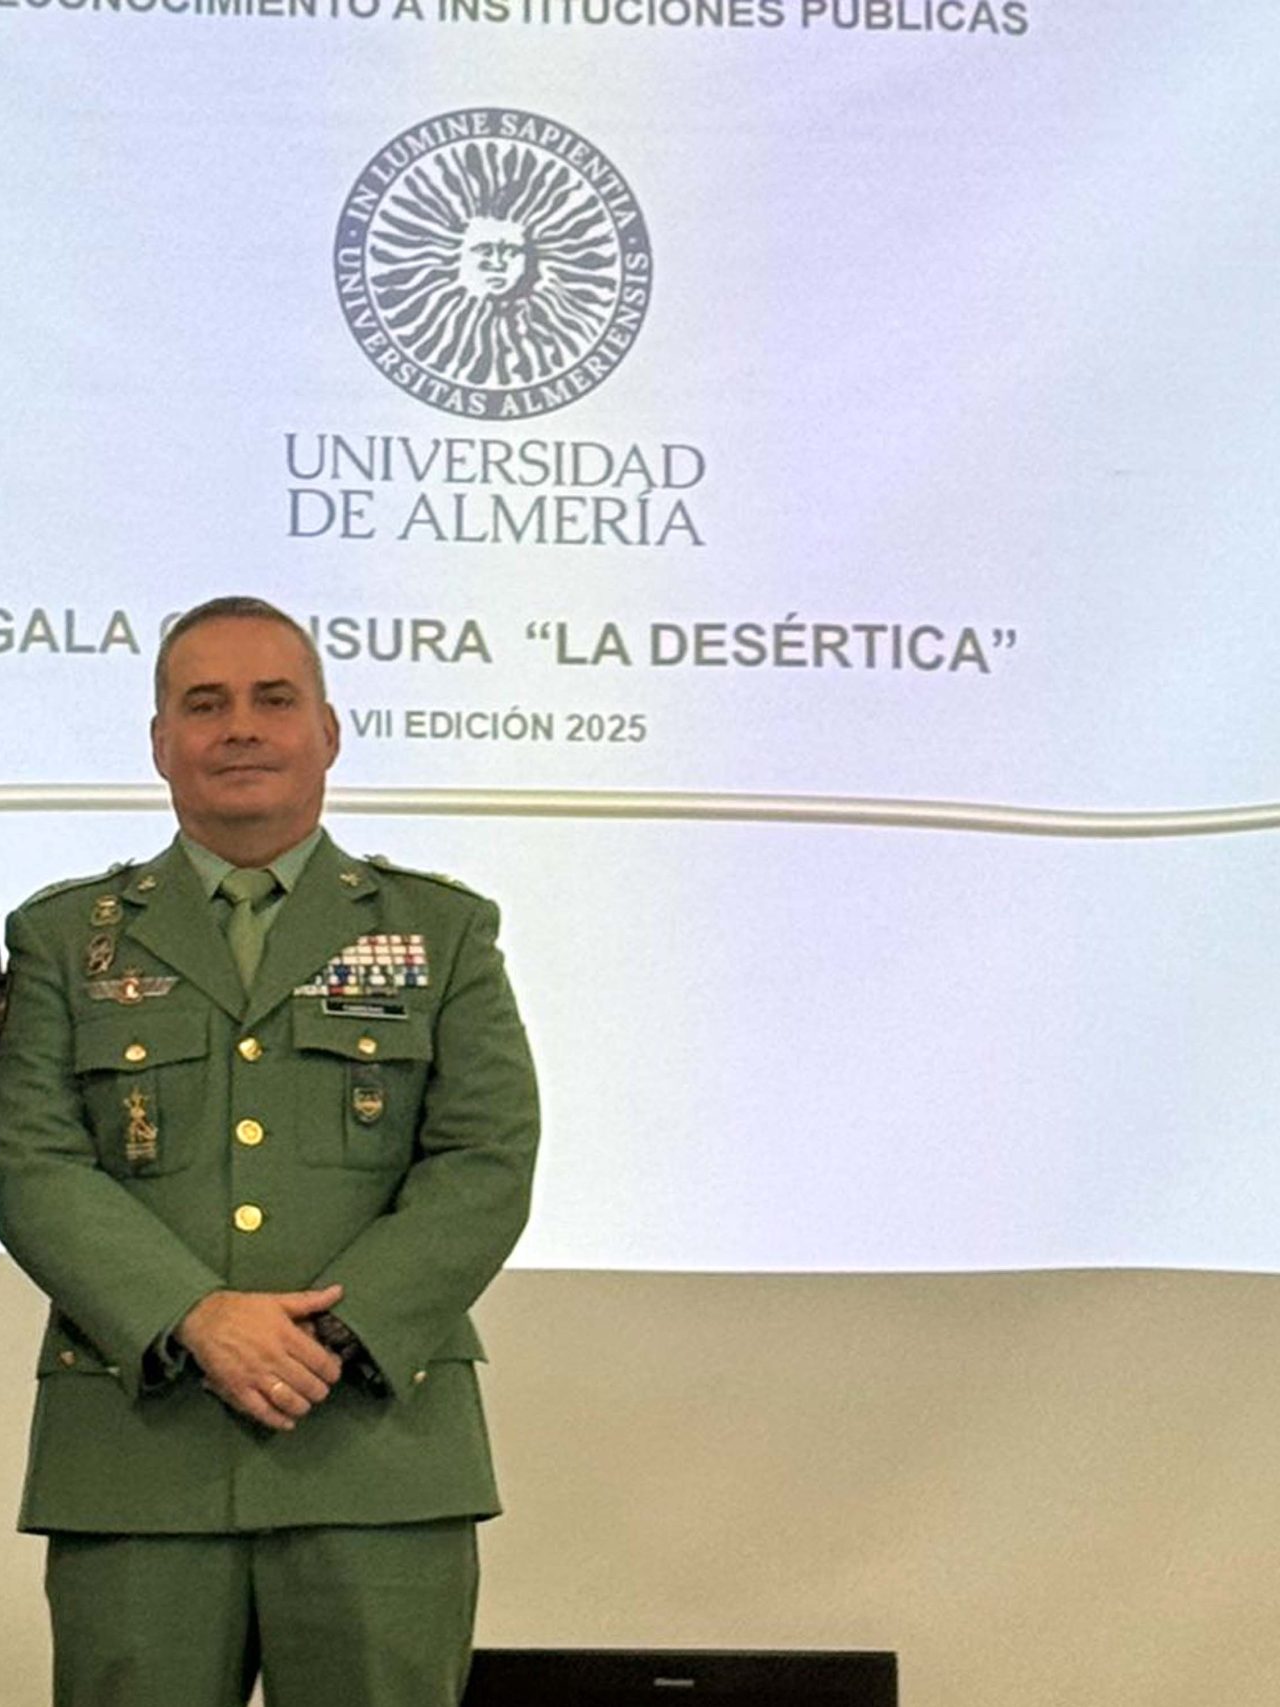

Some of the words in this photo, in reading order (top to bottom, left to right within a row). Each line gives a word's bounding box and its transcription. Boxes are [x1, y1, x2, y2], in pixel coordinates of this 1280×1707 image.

[392, 0, 426, 21] A
[438, 0, 784, 28] INSTITUCIONES
[348, 189, 374, 223] IN
[376, 111, 491, 184] LUMINE
[500, 111, 639, 230] SAPIENTIA
[338, 247, 488, 416] UNIVERSITAS
[500, 252, 649, 417] ALMERIENSIS
[284, 433, 707, 490] UNIVERSIDAD
[287, 488, 377, 540] DE
[397, 488, 707, 547] ALMERÍA
[649, 612, 1017, 674] DESÉRTICA”
[350, 709, 393, 739] VII
[405, 706, 554, 742] EDICIÓN
[566, 713, 648, 743] 2025
